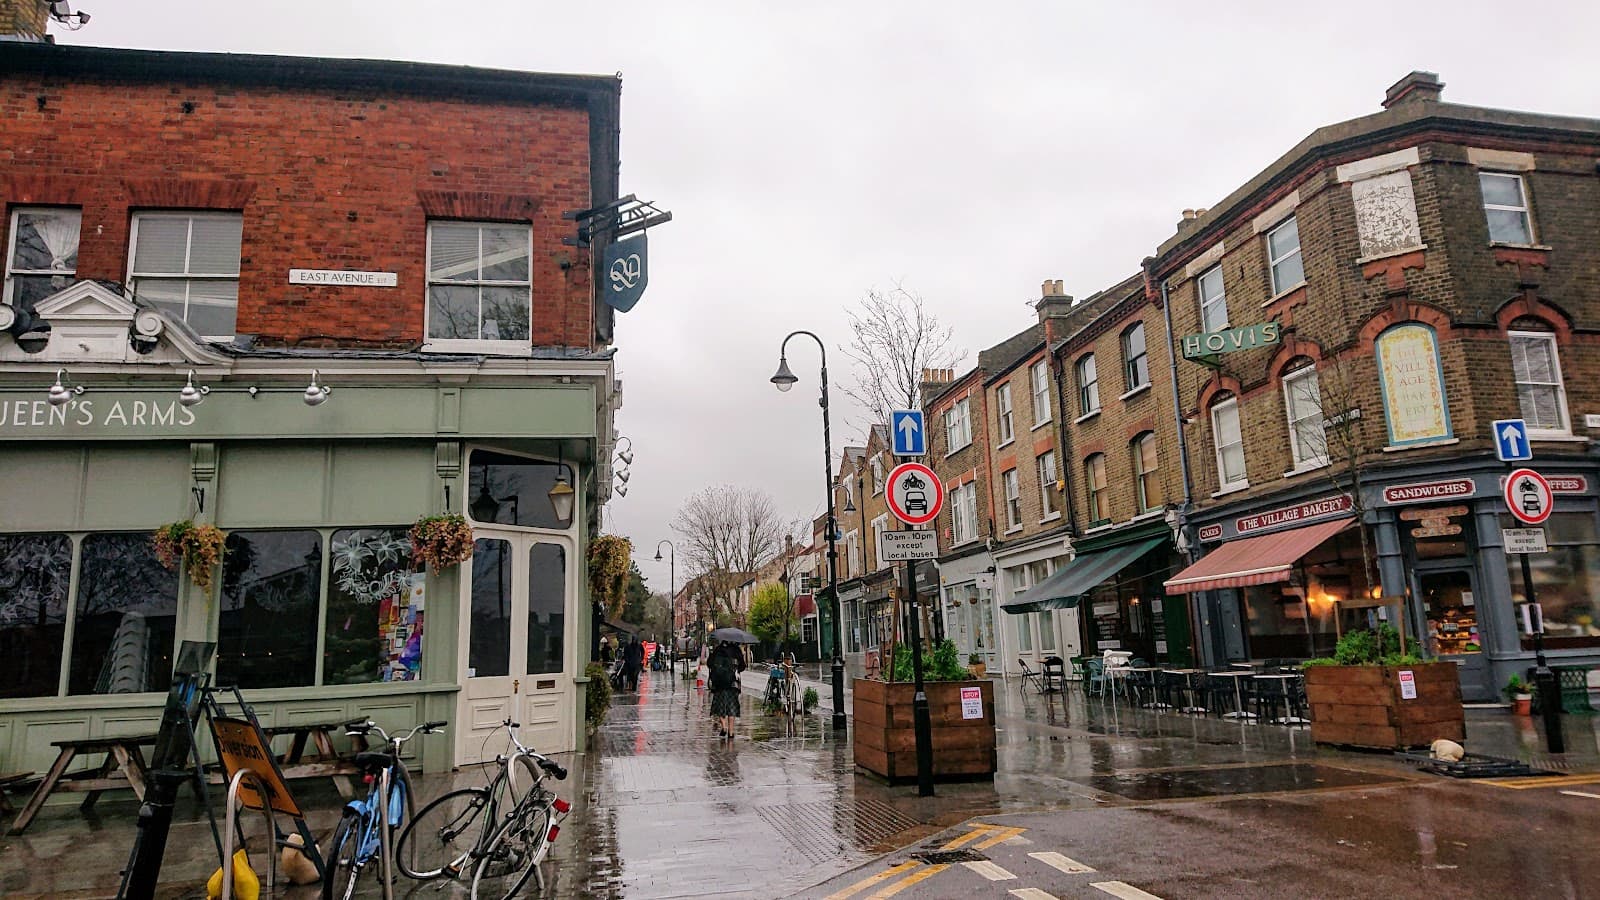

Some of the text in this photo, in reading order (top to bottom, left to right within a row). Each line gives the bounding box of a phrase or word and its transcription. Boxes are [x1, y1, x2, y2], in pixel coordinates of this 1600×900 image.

[300, 272, 329, 281] EAST
[331, 273, 374, 284] AVENUE
[1186, 324, 1277, 354] HOVIS
[1399, 375, 1426, 387] AGE
[104, 400, 196, 426] ARMS
[1390, 483, 1467, 499] SANDWICHES
[1242, 499, 1344, 530] THE VILLAGE BAKERY
[884, 533, 906, 541] 10am
[912, 532, 934, 540] 10pm
[1201, 527, 1219, 538] CAKES
[888, 551, 907, 559] local
[963, 691, 979, 699] STOP
